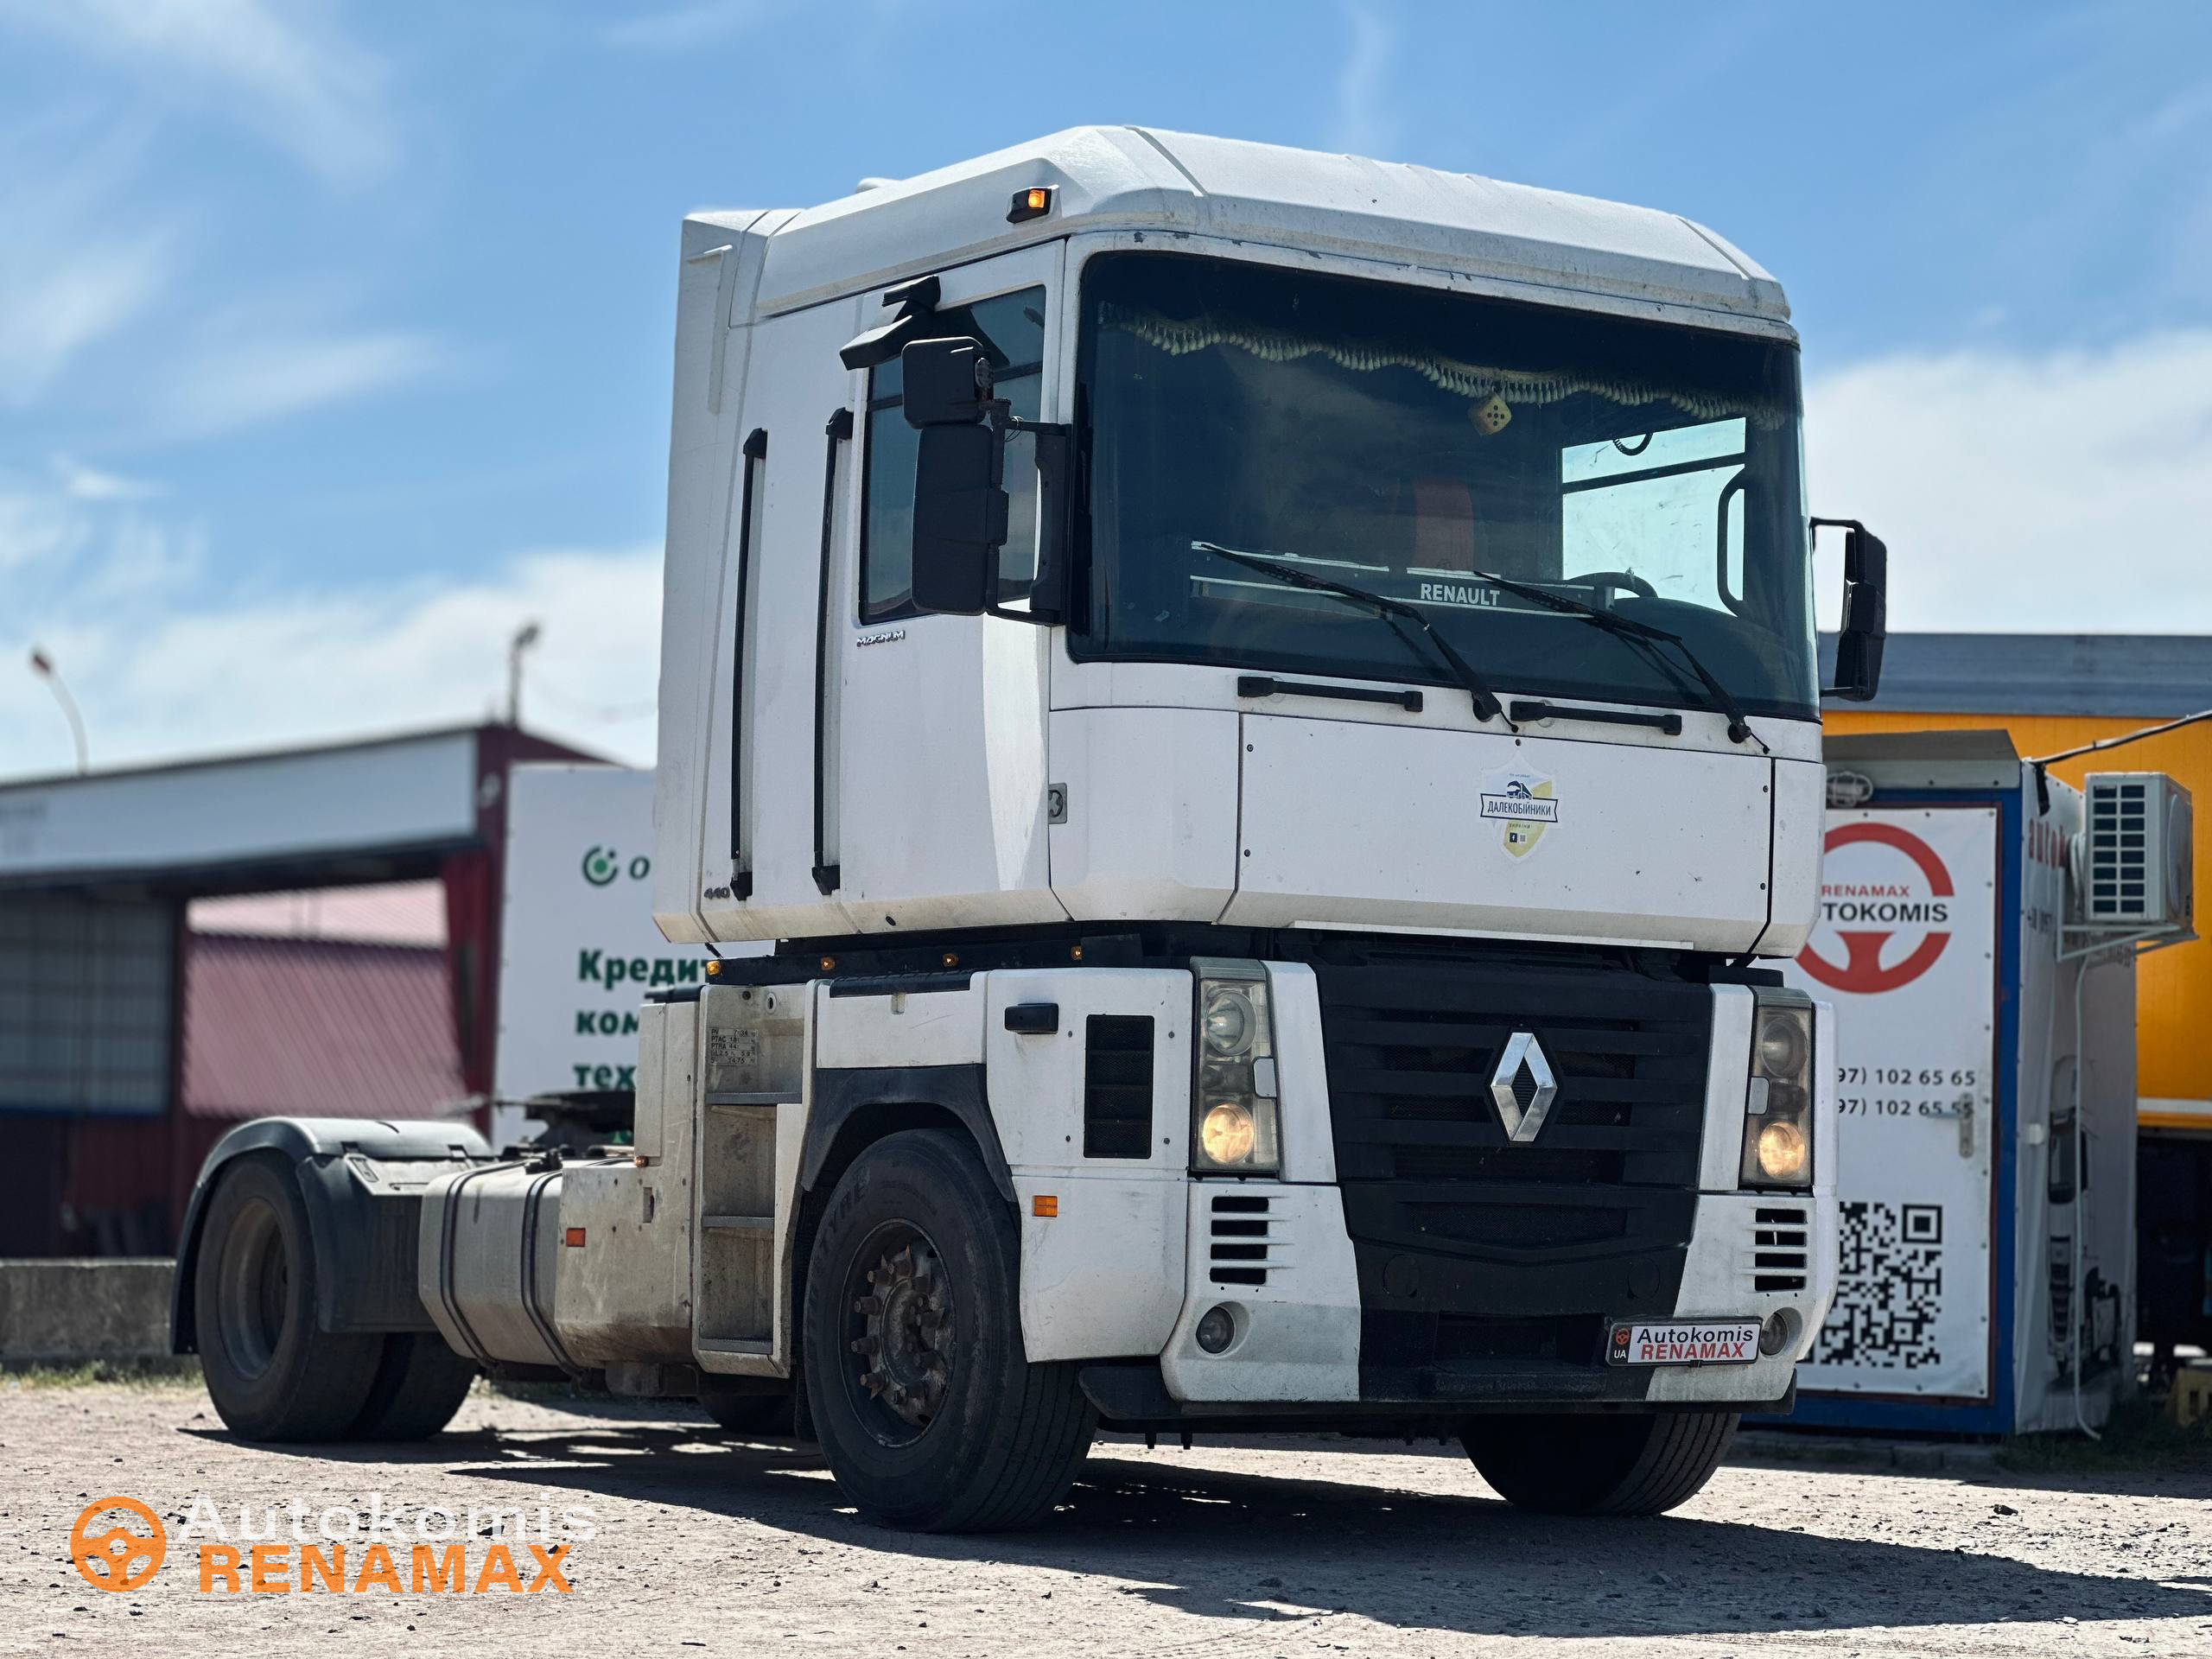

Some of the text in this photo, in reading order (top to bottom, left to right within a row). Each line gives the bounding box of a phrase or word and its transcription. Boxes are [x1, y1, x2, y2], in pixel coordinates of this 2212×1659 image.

[1421, 583, 1501, 607] RENAULT
[1487, 800, 1551, 817] ДАЛЕКОБІЙНИКИ
[704, 887, 731, 900] 440
[1821, 885, 1910, 898] RENAMAX
[1876, 1068, 1912, 1085] 102
[1919, 1069, 1943, 1085] 65
[1951, 1070, 1976, 1086] 65
[1876, 1099, 1911, 1116] 102
[1918, 1100, 1942, 1116] 65
[1637, 1325, 1754, 1344] Autokomis
[1613, 1350, 1627, 1359] UA
[1641, 1342, 1746, 1361] RENAMAX
